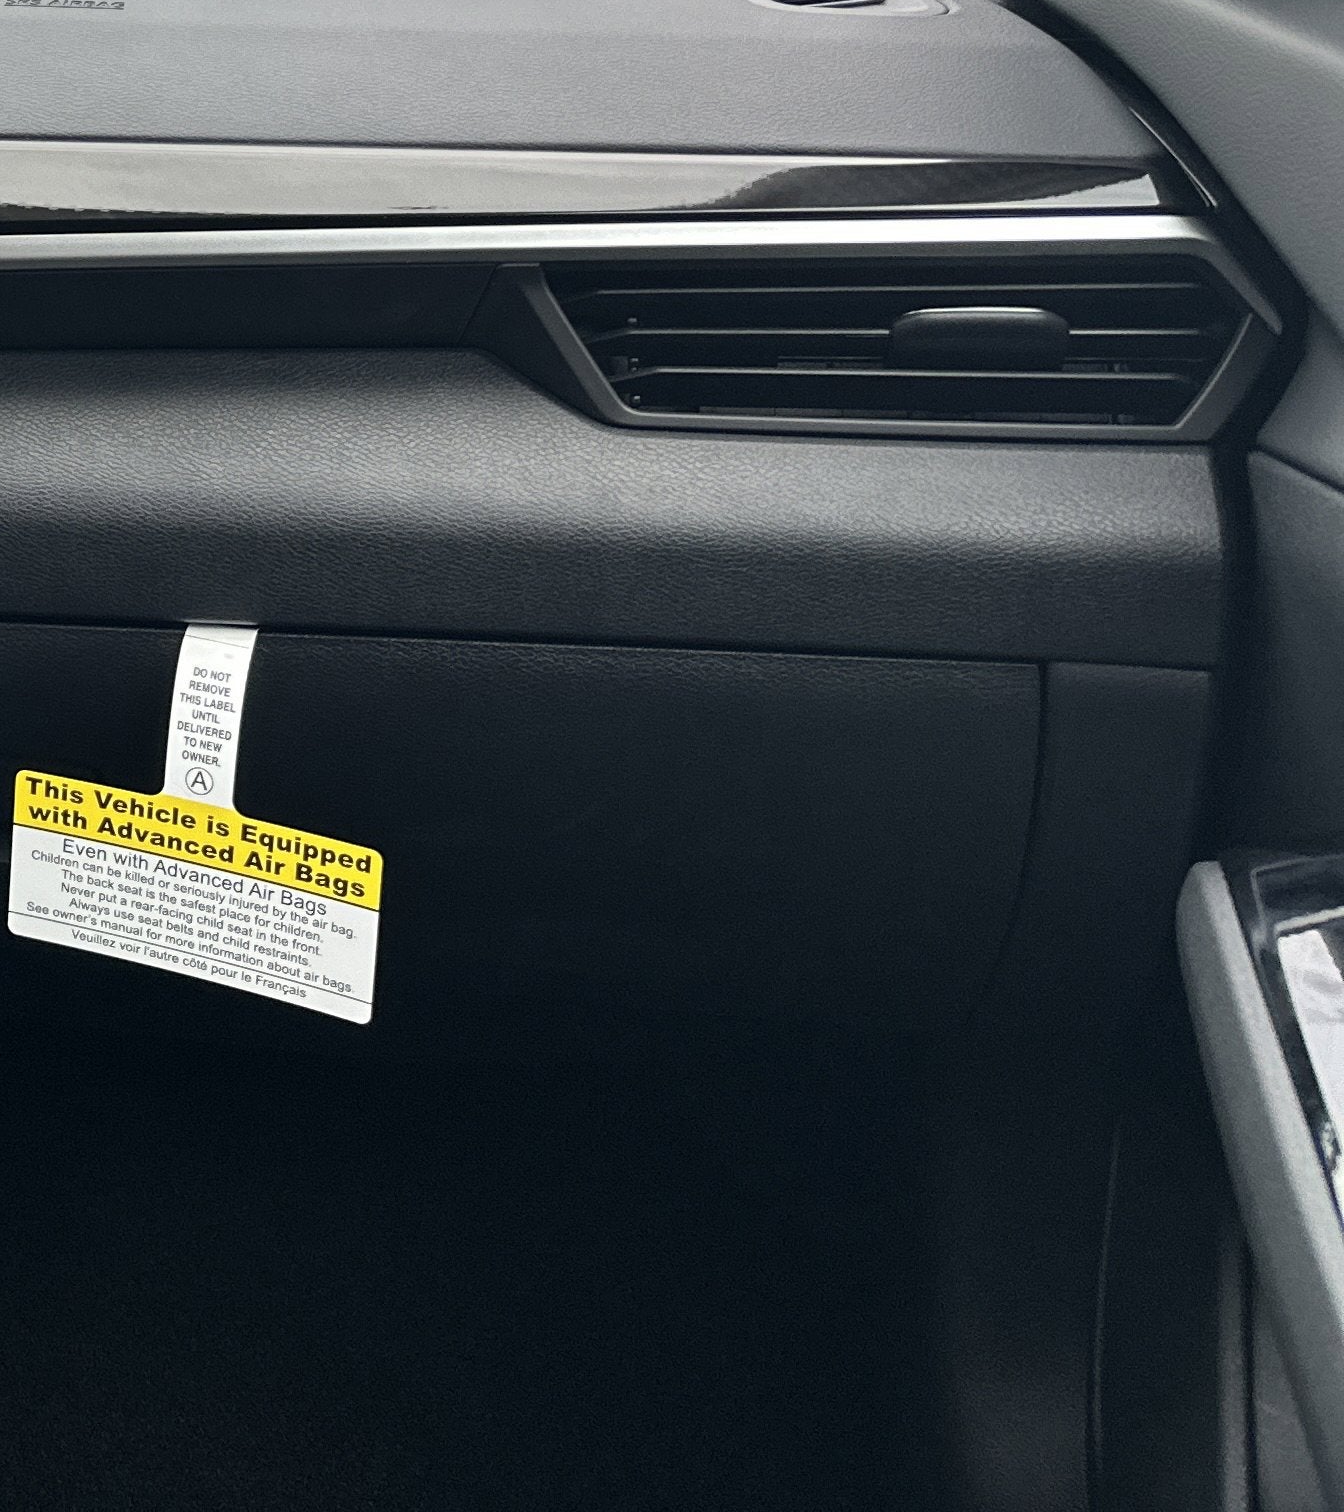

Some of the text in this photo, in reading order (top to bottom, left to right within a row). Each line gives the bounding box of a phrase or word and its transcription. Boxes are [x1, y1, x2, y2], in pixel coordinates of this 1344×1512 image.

[189, 679, 232, 698] REMOVE
[193, 667, 232, 683] DO NOT
[179, 692, 237, 714] THIS LABEL
[192, 709, 221, 725] UNTIL
[177, 720, 233, 742] DELIVERED
[183, 735, 223, 753] TO NEW
[181, 749, 222, 768] OWNER.
[190, 770, 208, 791] A
[25, 775, 371, 873] This Vehicle is Equipped
[28, 805, 365, 897] with Advanced Air Bags
[30, 849, 79, 869] Children
[82, 862, 103, 874] can
[106, 865, 121, 878] be
[124, 869, 155, 886] killed
[157, 879, 171, 889] or
[172, 883, 226, 905] seriously
[228, 894, 269, 914] injured
[272, 905, 287, 920] by
[289, 910, 308, 925] the
[312, 915, 329, 929] air
[60, 868, 83, 883] The
[86, 874, 114, 890] back
[117, 881, 143, 898] seat
[145, 887, 155, 899] is
[158, 891, 177, 905] the
[180, 898, 216, 914] safest
[218, 907, 251, 923] place
[254, 914, 271, 928] for
[62, 837, 327, 915] Even with Advanced Air Bags
[26, 900, 49, 915] See
[100, 919, 143, 936] manual
[145, 928, 162, 940] for
[164, 934, 195, 949] more
[198, 941, 263, 967] information
[266, 961, 301, 978] about
[303, 971, 320, 982] air
[60, 881, 96, 898] Never
[98, 890, 117, 904] put
[119, 897, 127, 906] a
[130, 899, 193, 924] rear-facing
[196, 915, 224, 930] child
[227, 923, 253, 937] seat
[255, 928, 266, 941] in
[269, 932, 289, 947] the
[67, 897, 110, 916] Always
[113, 908, 135, 921] use
[137, 914, 163, 928] seat
[165, 919, 194, 935] belts
[196, 929, 219, 942] and
[222, 935, 250, 951] child
[117, 941, 141, 954] voir
[182, 957, 208, 971] côté
[210, 964, 238, 978] pour
[240, 970, 252, 983] le
[255, 974, 307, 998] Français
